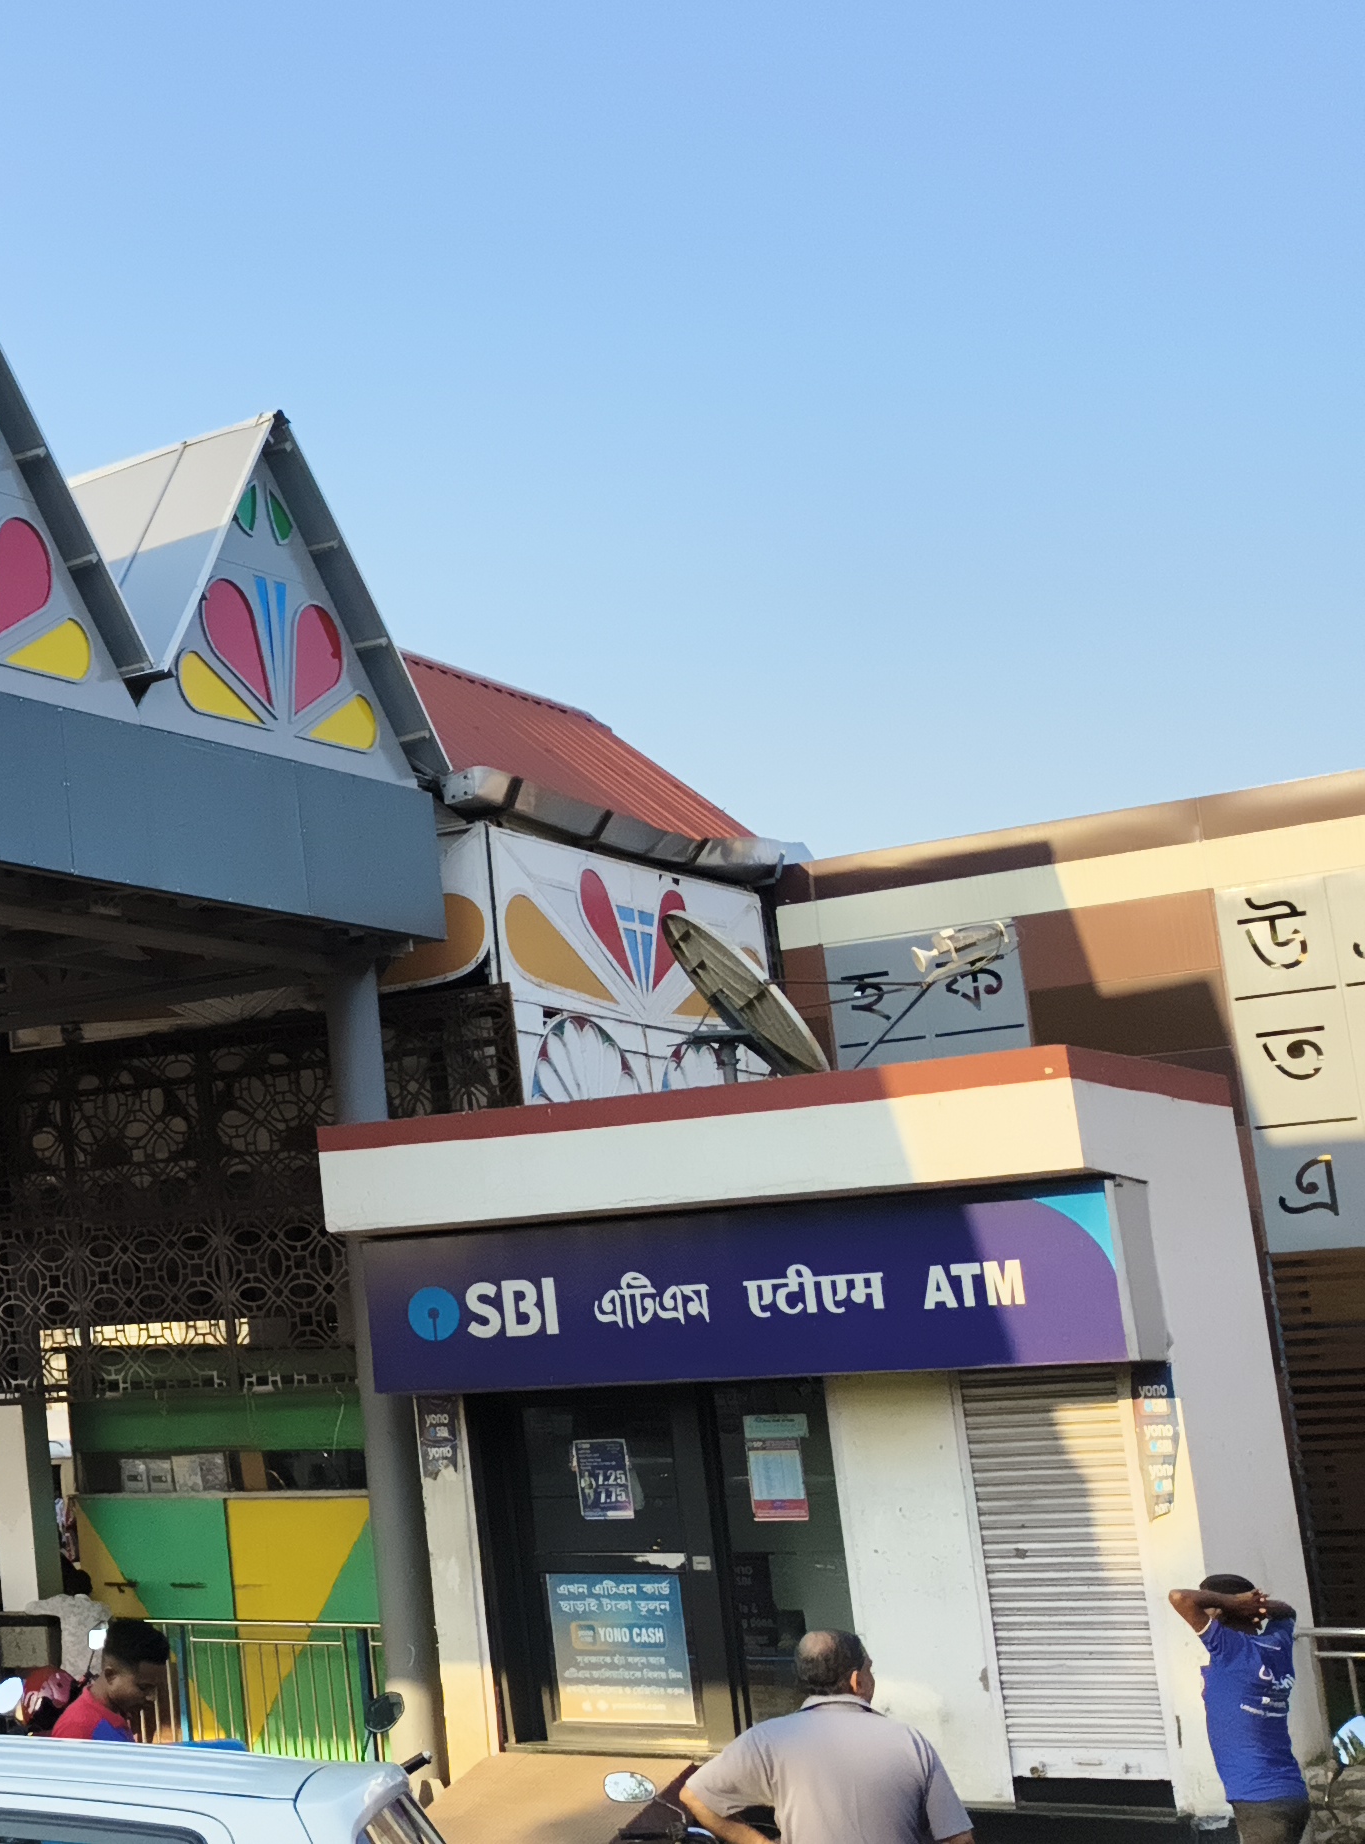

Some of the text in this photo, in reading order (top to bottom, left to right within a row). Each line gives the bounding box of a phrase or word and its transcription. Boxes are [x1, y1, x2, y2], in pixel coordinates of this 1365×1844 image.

[1237, 898, 1309, 970] উ
[594, 1271, 710, 1329] এটিএম
[743, 1264, 884, 1318] एटीएम
[923, 1259, 1026, 1310] ATM
[466, 1277, 559, 1338] SBI
[1139, 1384, 1167, 1399] yono
[425, 1414, 449, 1427] yono
[1143, 1424, 1173, 1440] yono
[428, 1447, 453, 1460] yono
[598, 1627, 629, 1643] YONO
[632, 1627, 664, 1643] CASH
